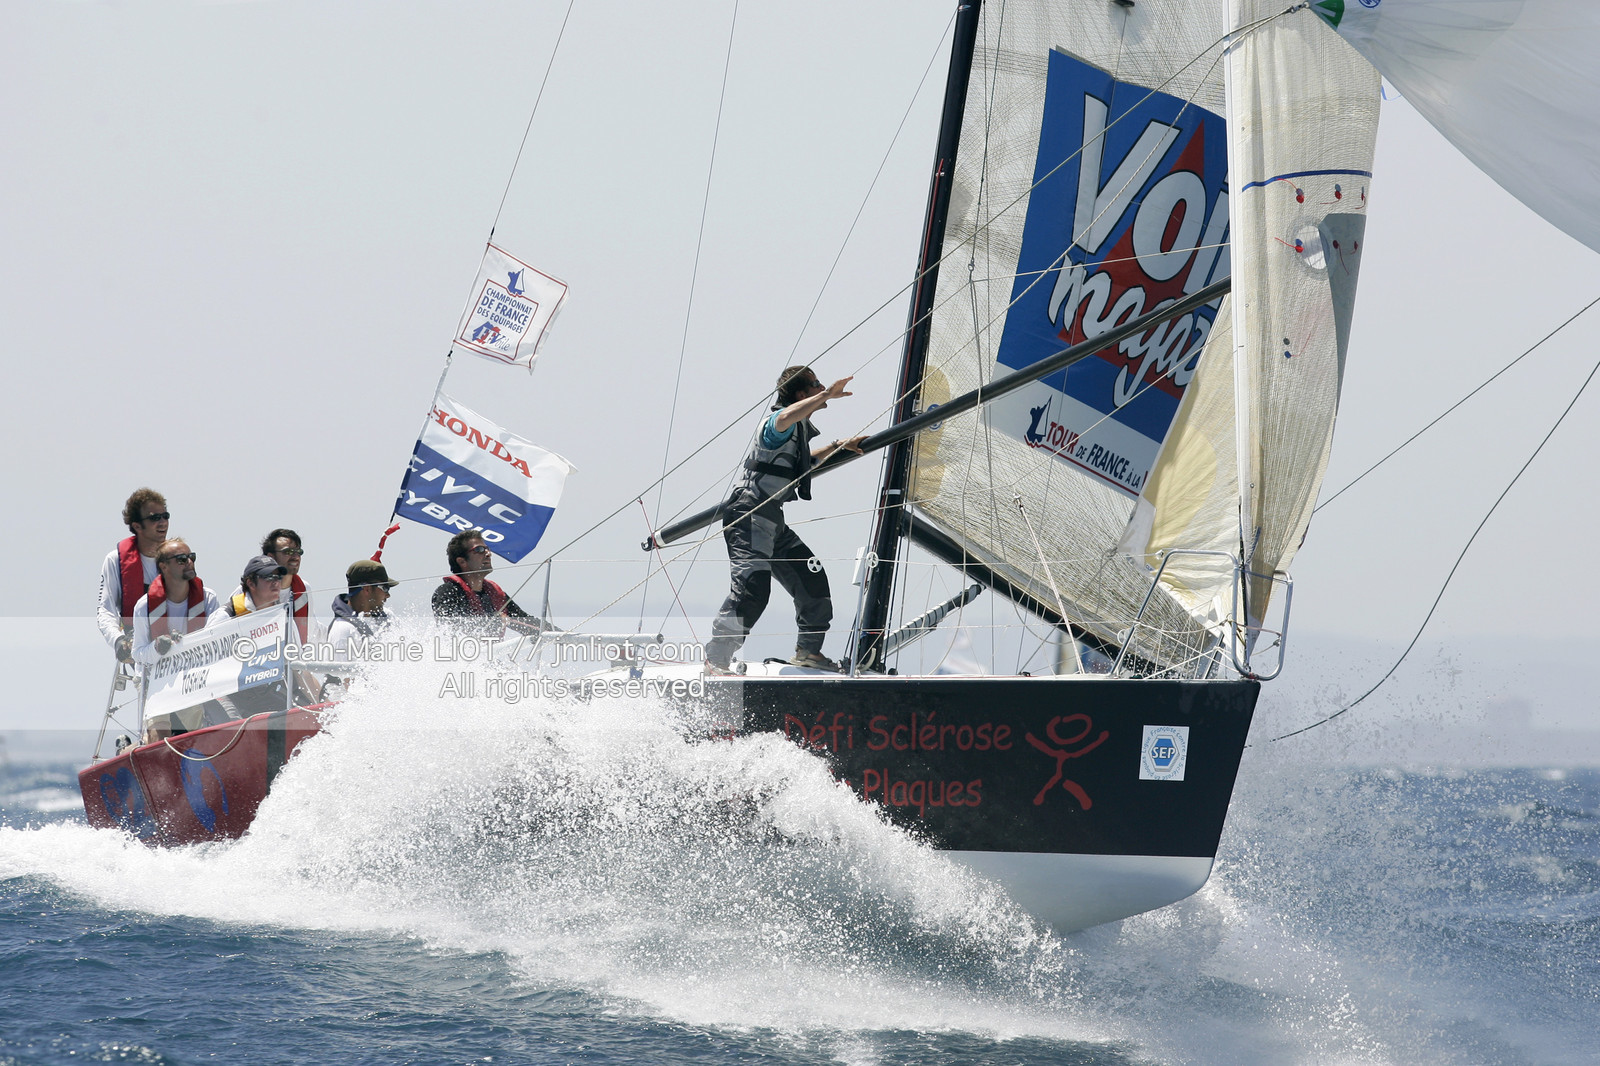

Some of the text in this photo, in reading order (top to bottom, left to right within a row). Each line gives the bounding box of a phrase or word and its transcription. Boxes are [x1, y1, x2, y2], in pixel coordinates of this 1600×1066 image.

[480, 295, 529, 325] DE FRANCE
[486, 287, 532, 315] CHAMPIONNAT
[476, 306, 524, 334] DES EQUIPAGES
[1046, 421, 1080, 455] TOUR
[1075, 445, 1088, 460] DE
[1086, 443, 1130, 480] FRANCE
[1131, 475, 1141, 489] LA
[402, 489, 505, 543] YBRD
[249, 622, 280, 640] HONDA
[154, 656, 172, 680] DEFI
[170, 645, 203, 675] SCLEROSE
[201, 642, 213, 665] EN
[244, 667, 279, 684] HYBRID
[181, 668, 210, 696] TOSHIBA
[784, 711, 854, 752] Défi
[866, 711, 1013, 751] Sclérose
[1152, 746, 1176, 759] SEP
[863, 768, 982, 818] Plaques
